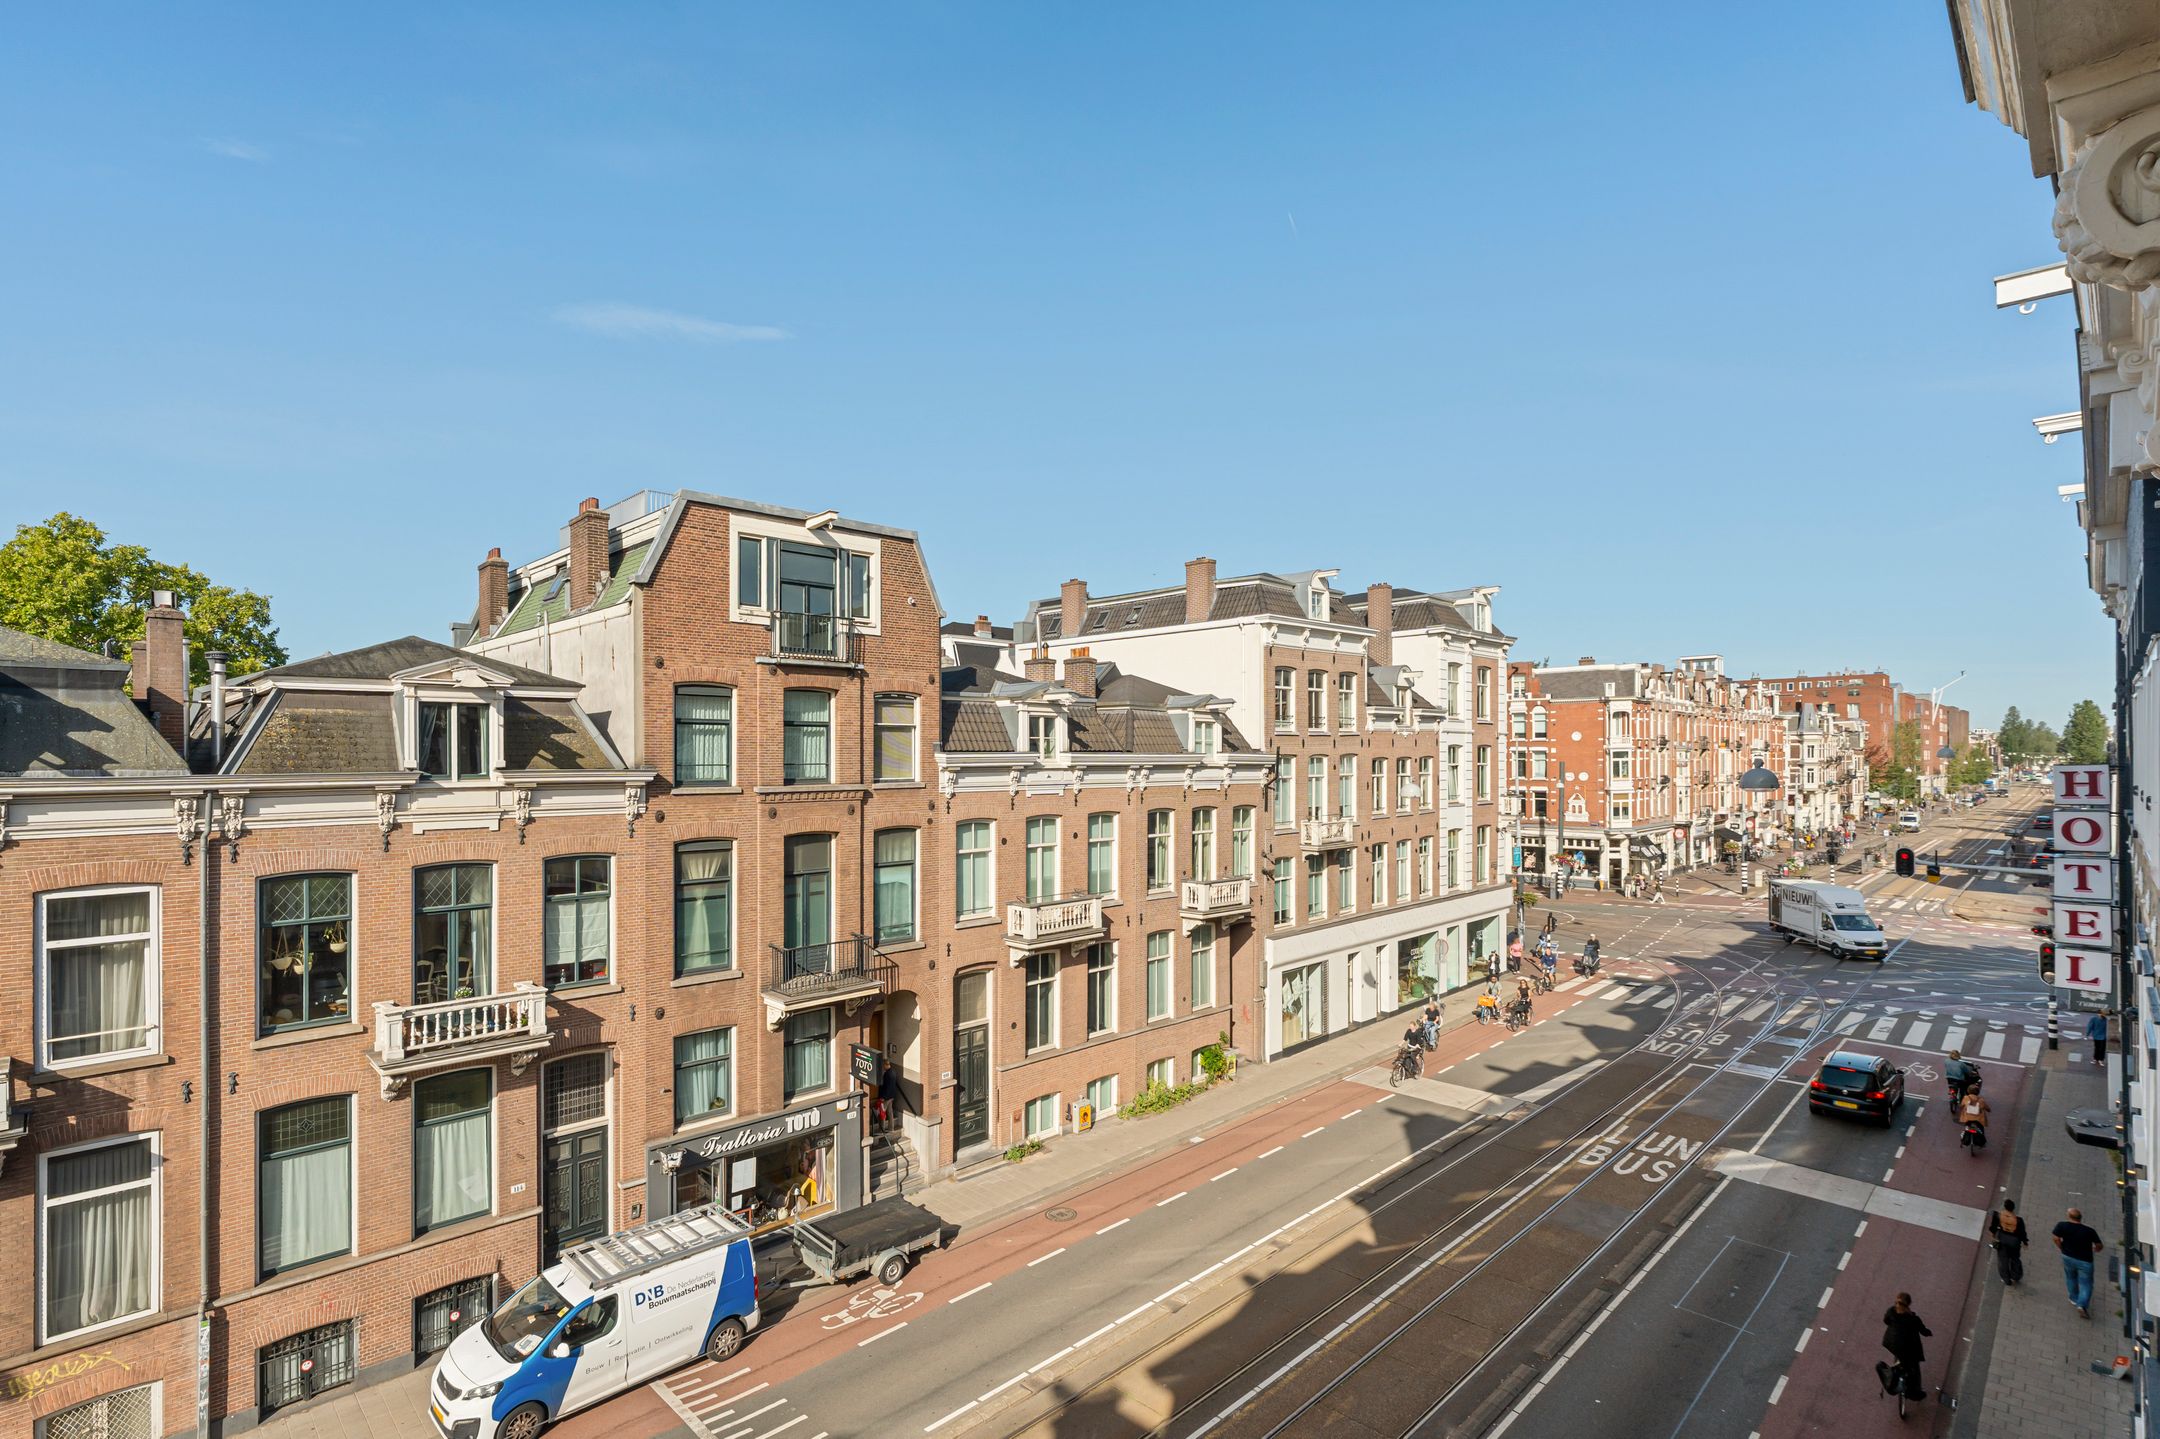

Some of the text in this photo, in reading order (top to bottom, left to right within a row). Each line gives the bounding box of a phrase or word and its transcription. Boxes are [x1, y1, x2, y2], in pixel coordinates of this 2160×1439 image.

[2060, 770, 2104, 986] HOTEL
[1782, 888, 1813, 907] NIEUW!
[700, 1126, 785, 1158] Trattoria
[1577, 1144, 1676, 1183] BUS
[648, 1276, 717, 1310] Bouwmaatschappij
[585, 1362, 605, 1375] Bouw
